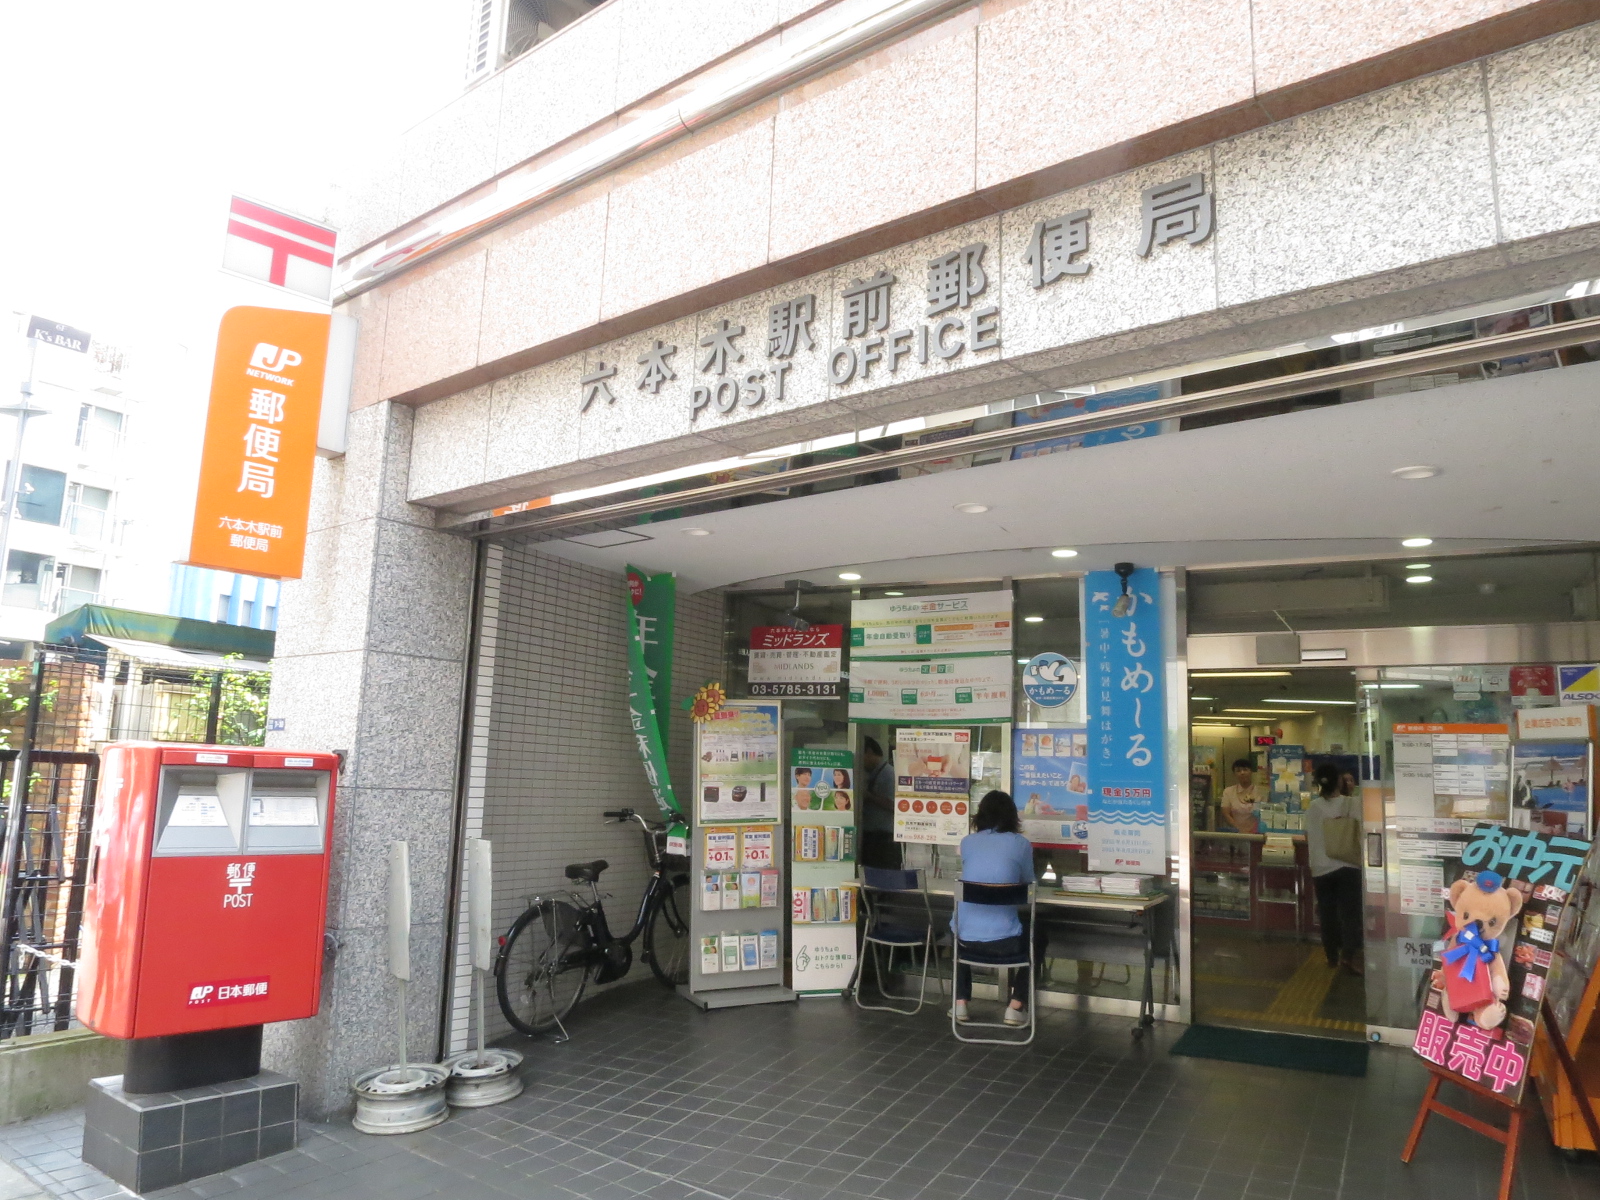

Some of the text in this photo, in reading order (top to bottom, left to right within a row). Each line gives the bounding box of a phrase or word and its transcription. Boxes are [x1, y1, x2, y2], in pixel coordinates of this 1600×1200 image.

[580, 172, 1213, 412] 六本木駅前郵便局
[54, 333, 82, 351] BAR
[249, 342, 302, 372] JP
[689, 304, 1001, 421] POST OFFICE
[246, 367, 294, 387] NETWORK
[237, 387, 286, 499] 郵便局
[218, 515, 283, 539] 六本木駅前
[229, 533, 269, 553] 郵便局
[762, 632, 830, 647] ミッドランズ
[774, 662, 814, 670] MIDLANDS
[752, 684, 836, 695] 03-5785-3131
[1102, 786, 1152, 798] 現金5万円
[1462, 825, 1592, 893] お中元
[226, 861, 256, 879] 郵便
[223, 893, 254, 908] POST
[218, 981, 268, 1000] 日本郵便
[1413, 1009, 1524, 1093] 販売中
